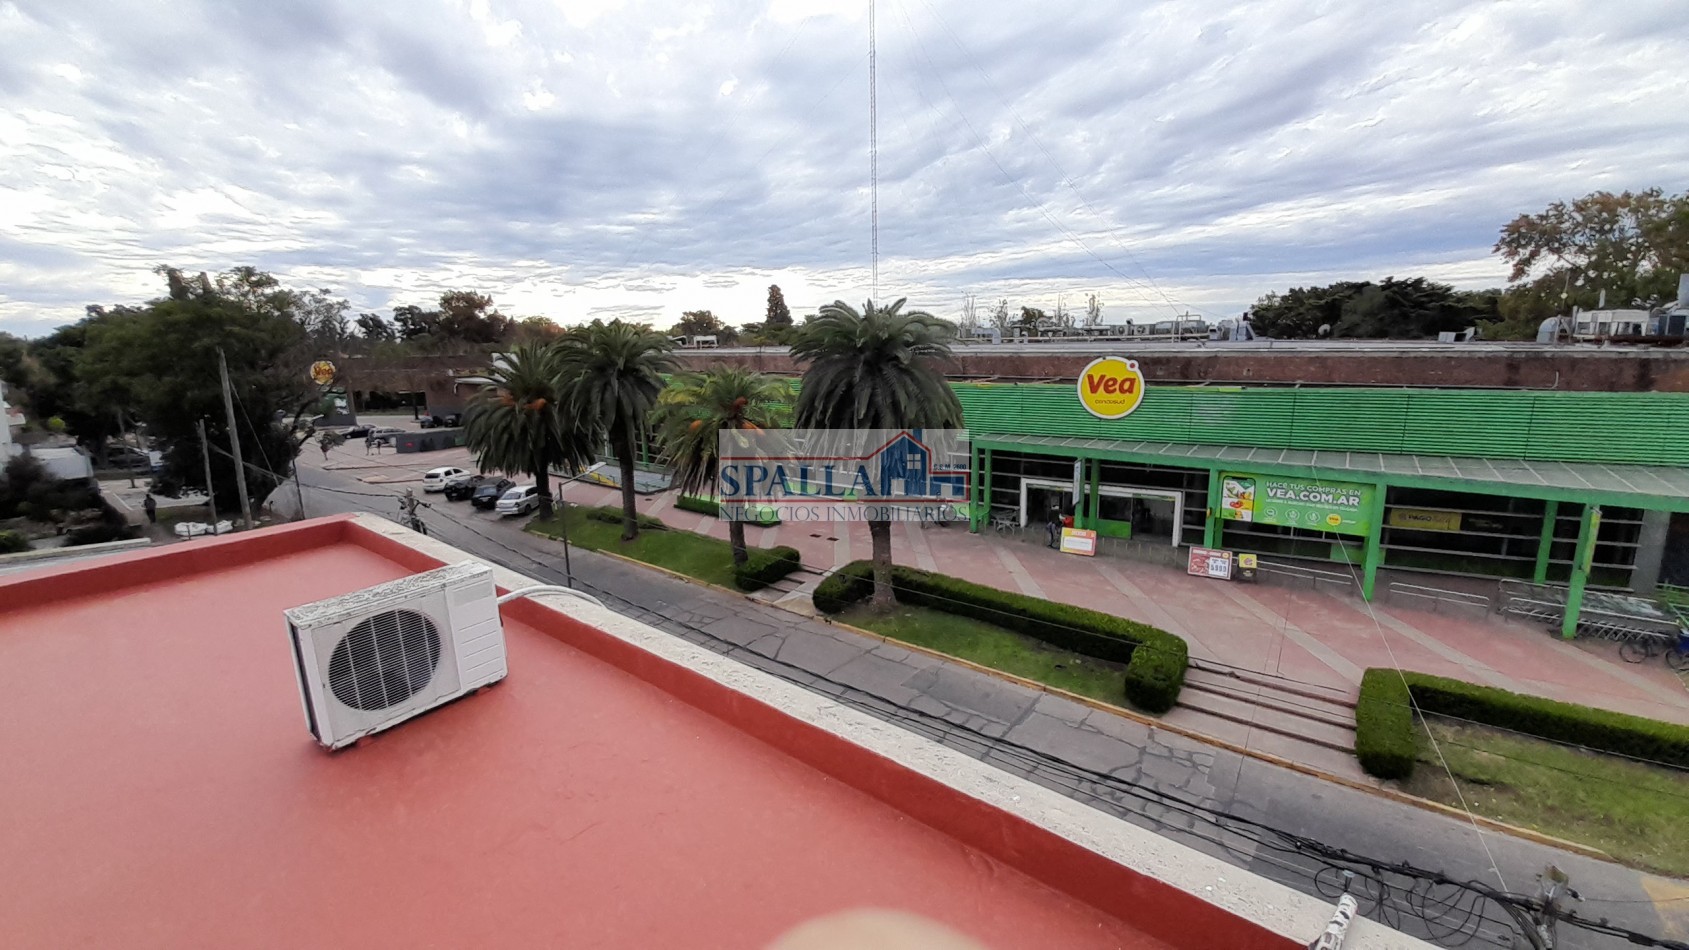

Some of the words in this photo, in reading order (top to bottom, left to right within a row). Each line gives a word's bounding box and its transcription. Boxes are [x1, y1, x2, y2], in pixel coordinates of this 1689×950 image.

[1087, 374, 1137, 394] Vea
[1266, 481, 1287, 489] HACE
[1289, 482, 1305, 491] TUS
[1306, 484, 1348, 496] COMPRAS
[1349, 488, 1362, 497] EN
[1266, 487, 1361, 507] VEA.COM.AR
